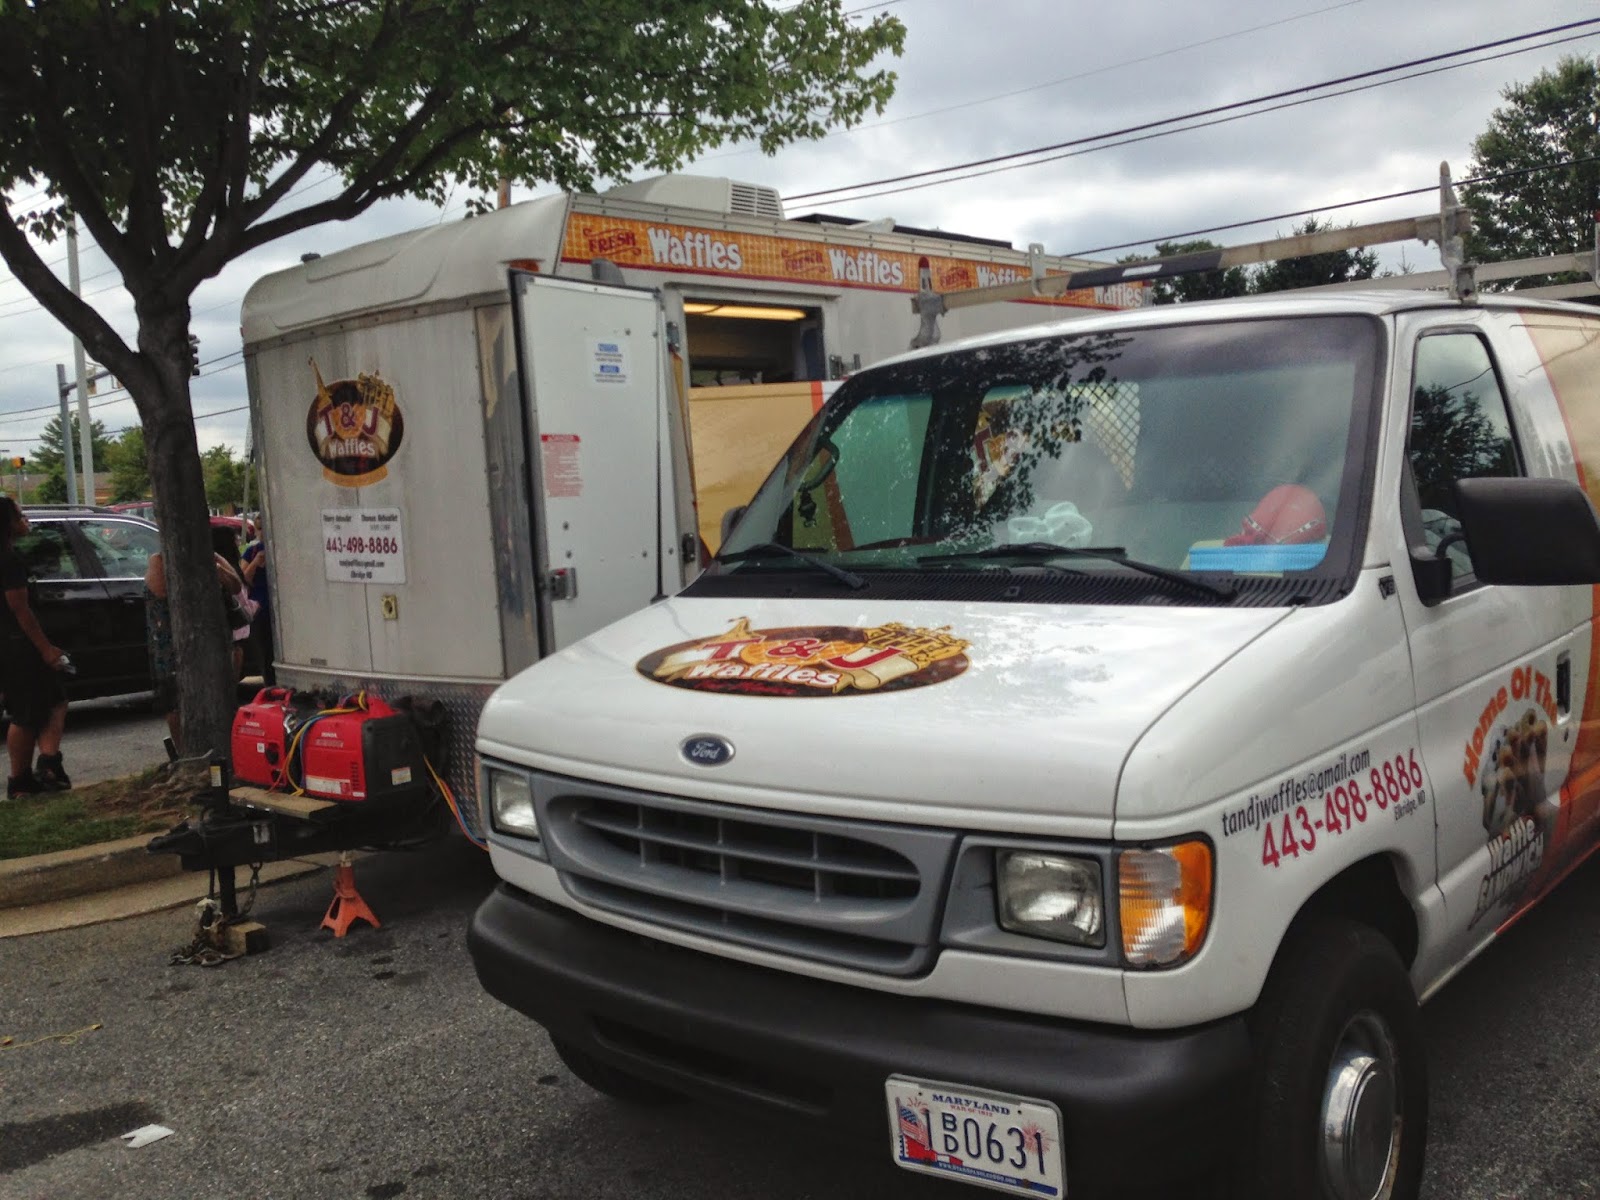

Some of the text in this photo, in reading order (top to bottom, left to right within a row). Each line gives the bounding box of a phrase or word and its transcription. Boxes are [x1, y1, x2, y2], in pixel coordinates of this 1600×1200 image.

[648, 228, 742, 270] Waffles
[828, 249, 904, 286] Waffles
[318, 402, 380, 436] T & J
[328, 439, 376, 459] Waffles
[326, 536, 398, 554] 443-498-8886
[702, 638, 905, 669] T & J
[688, 663, 842, 687] Waffles
[691, 742, 721, 759] Ford
[1463, 686, 1508, 791] Home
[1222, 749, 1371, 837] tandjwaffles@gmail.com
[1262, 748, 1422, 868] 443-498-8886
[932, 1093, 1010, 1115] MARYLAND
